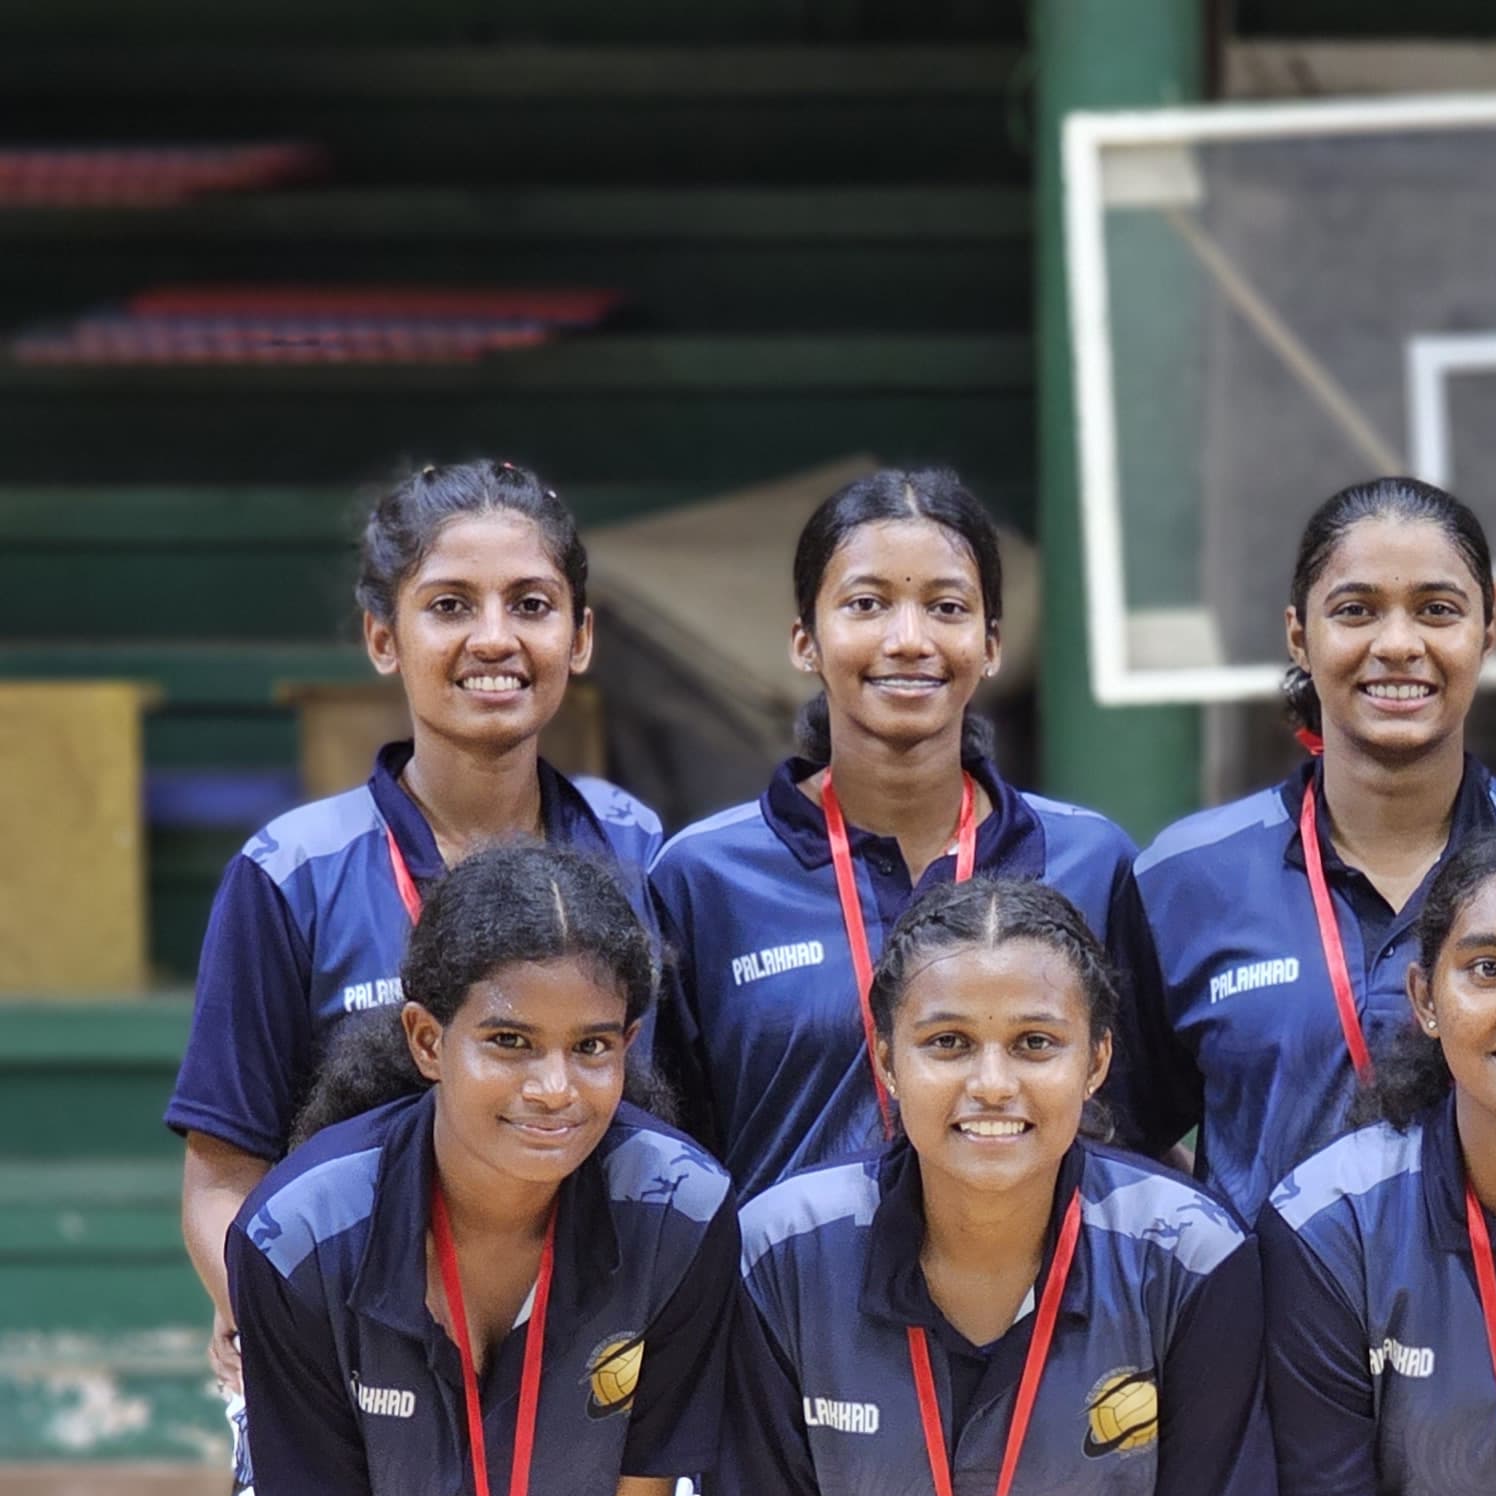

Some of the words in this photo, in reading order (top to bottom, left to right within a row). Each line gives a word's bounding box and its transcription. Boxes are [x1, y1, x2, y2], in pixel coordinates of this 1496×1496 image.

[731, 940, 824, 986] PALAKKAD
[1210, 957, 1299, 1004] PALAKKAD
[803, 1396, 880, 1434] LAKKAD
